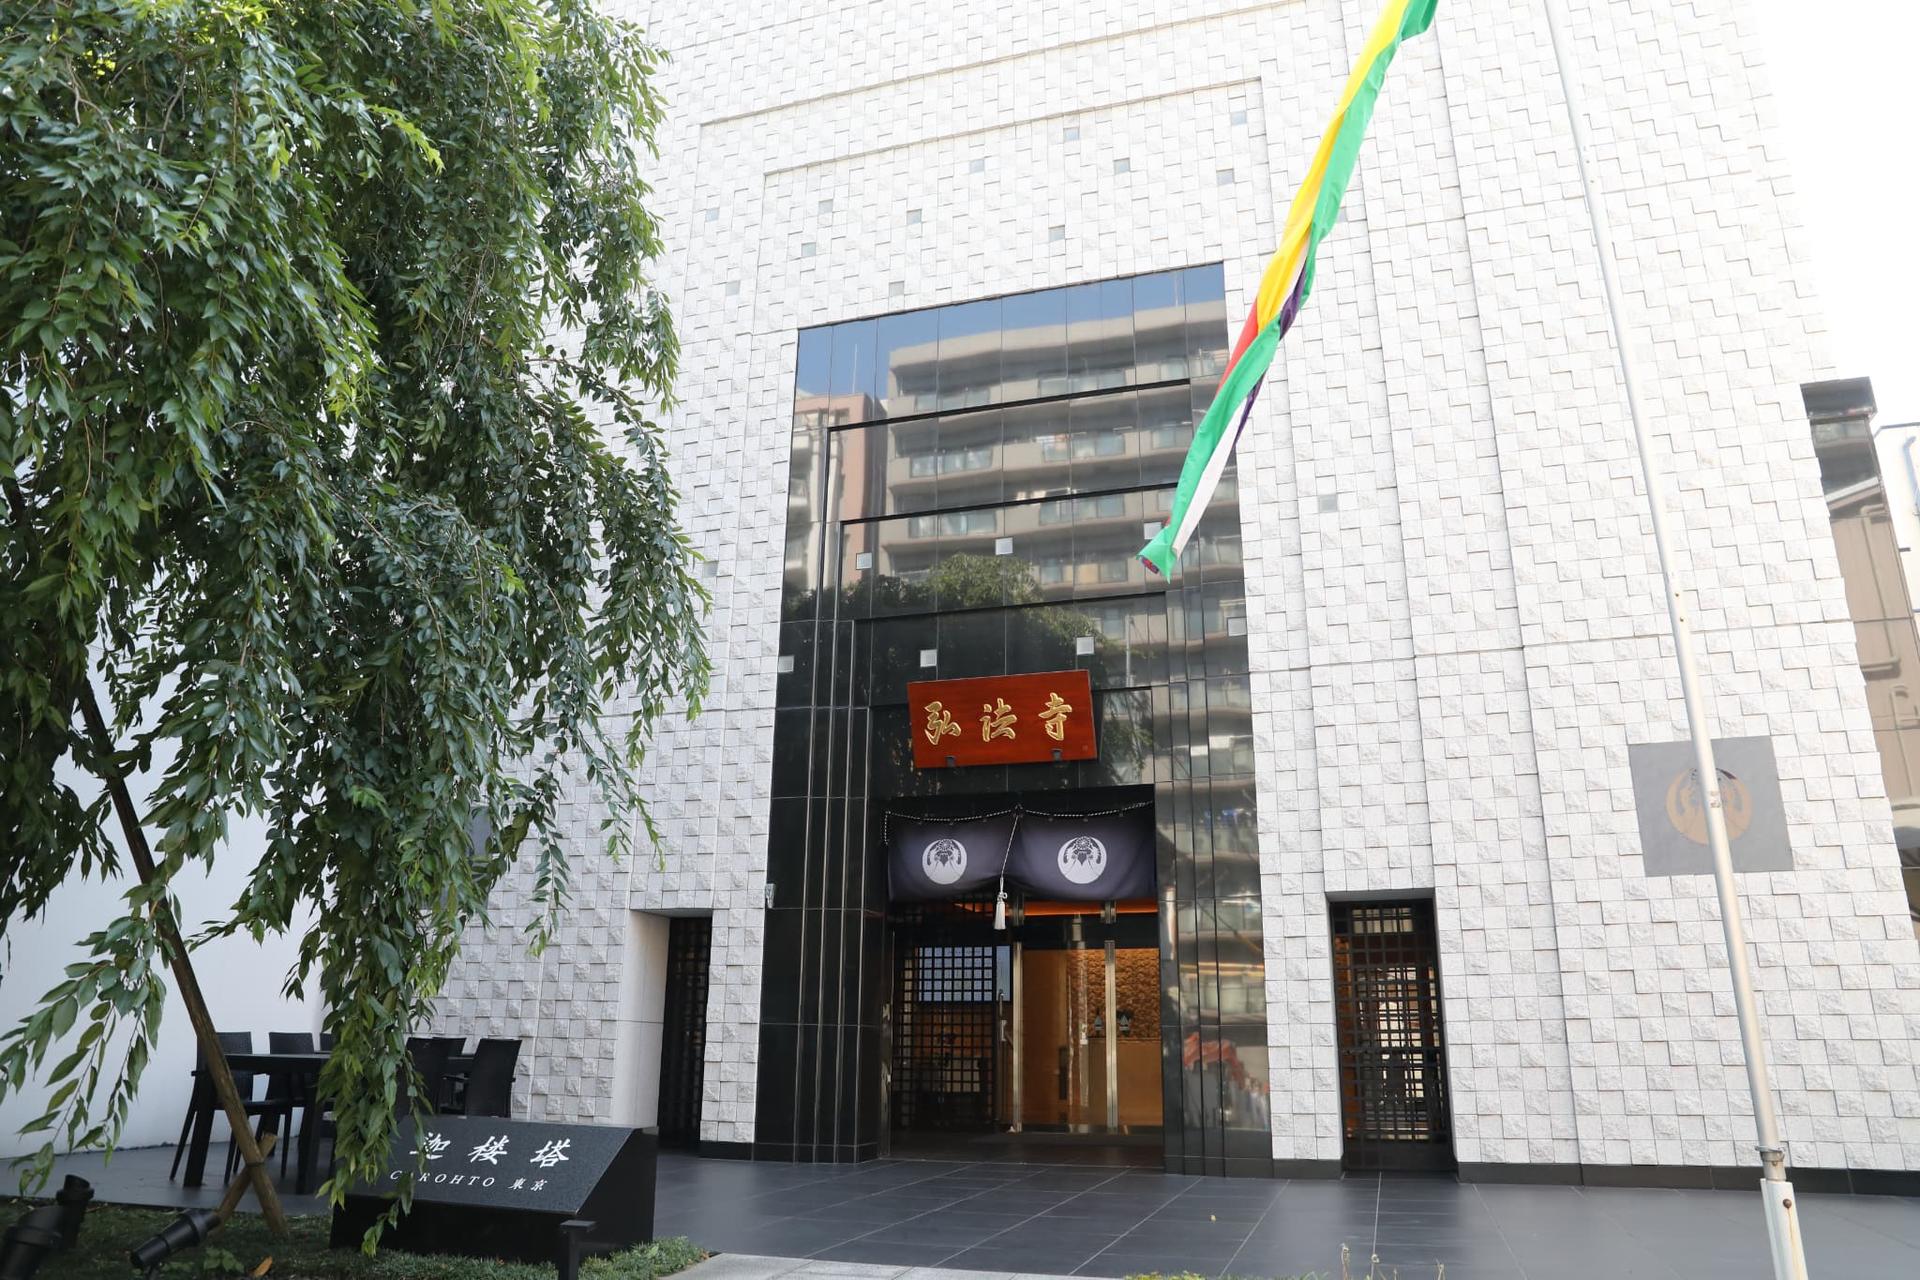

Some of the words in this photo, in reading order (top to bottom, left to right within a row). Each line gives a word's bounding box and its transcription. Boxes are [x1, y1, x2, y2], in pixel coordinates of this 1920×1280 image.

[924, 692, 1073, 746] 弘法寺
[389, 1170, 495, 1187] CROHTO
[508, 1176, 548, 1192] 東京
